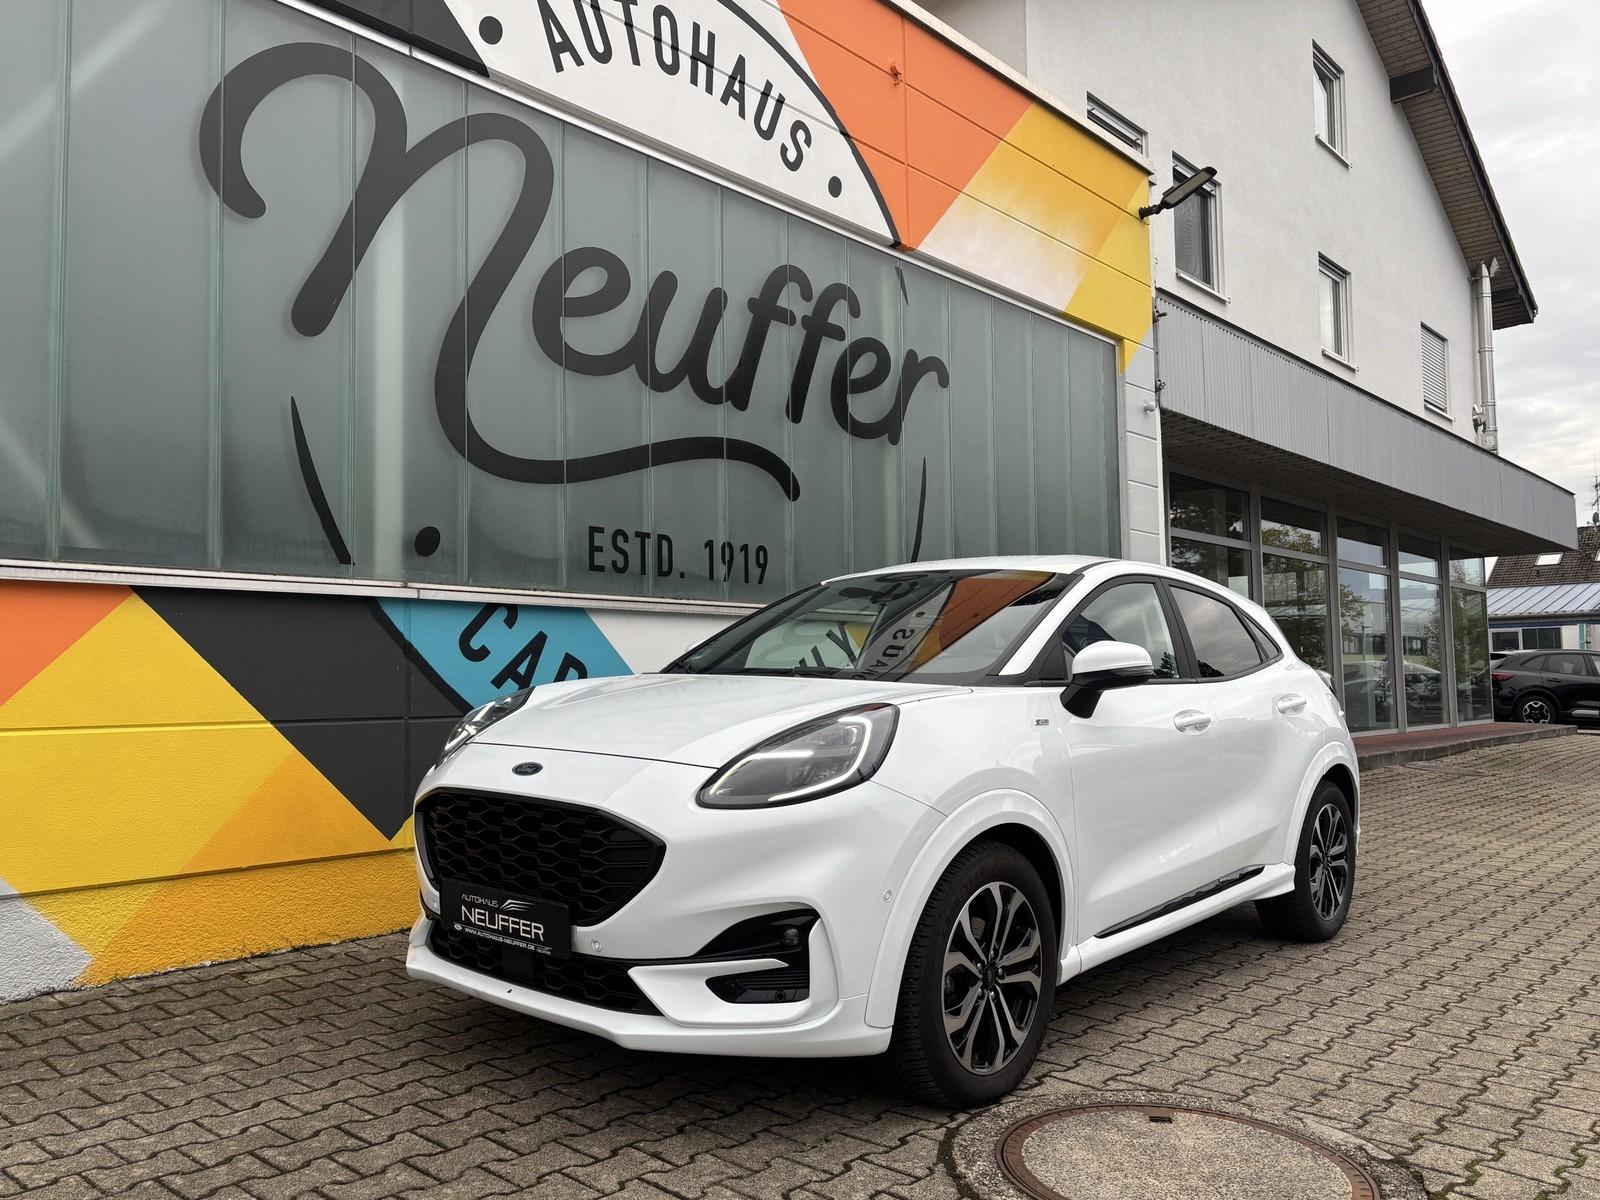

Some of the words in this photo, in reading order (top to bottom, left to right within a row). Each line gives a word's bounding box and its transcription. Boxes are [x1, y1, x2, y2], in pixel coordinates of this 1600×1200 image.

[536, 0, 813, 173] AUTOHAUS
[199, 41, 950, 503] Neuffer
[588, 525, 686, 578] ESTD.
[703, 538, 769, 585] 1919
[460, 904, 545, 942] NEUFFER
[461, 893, 499, 908] AUTOHAUS
